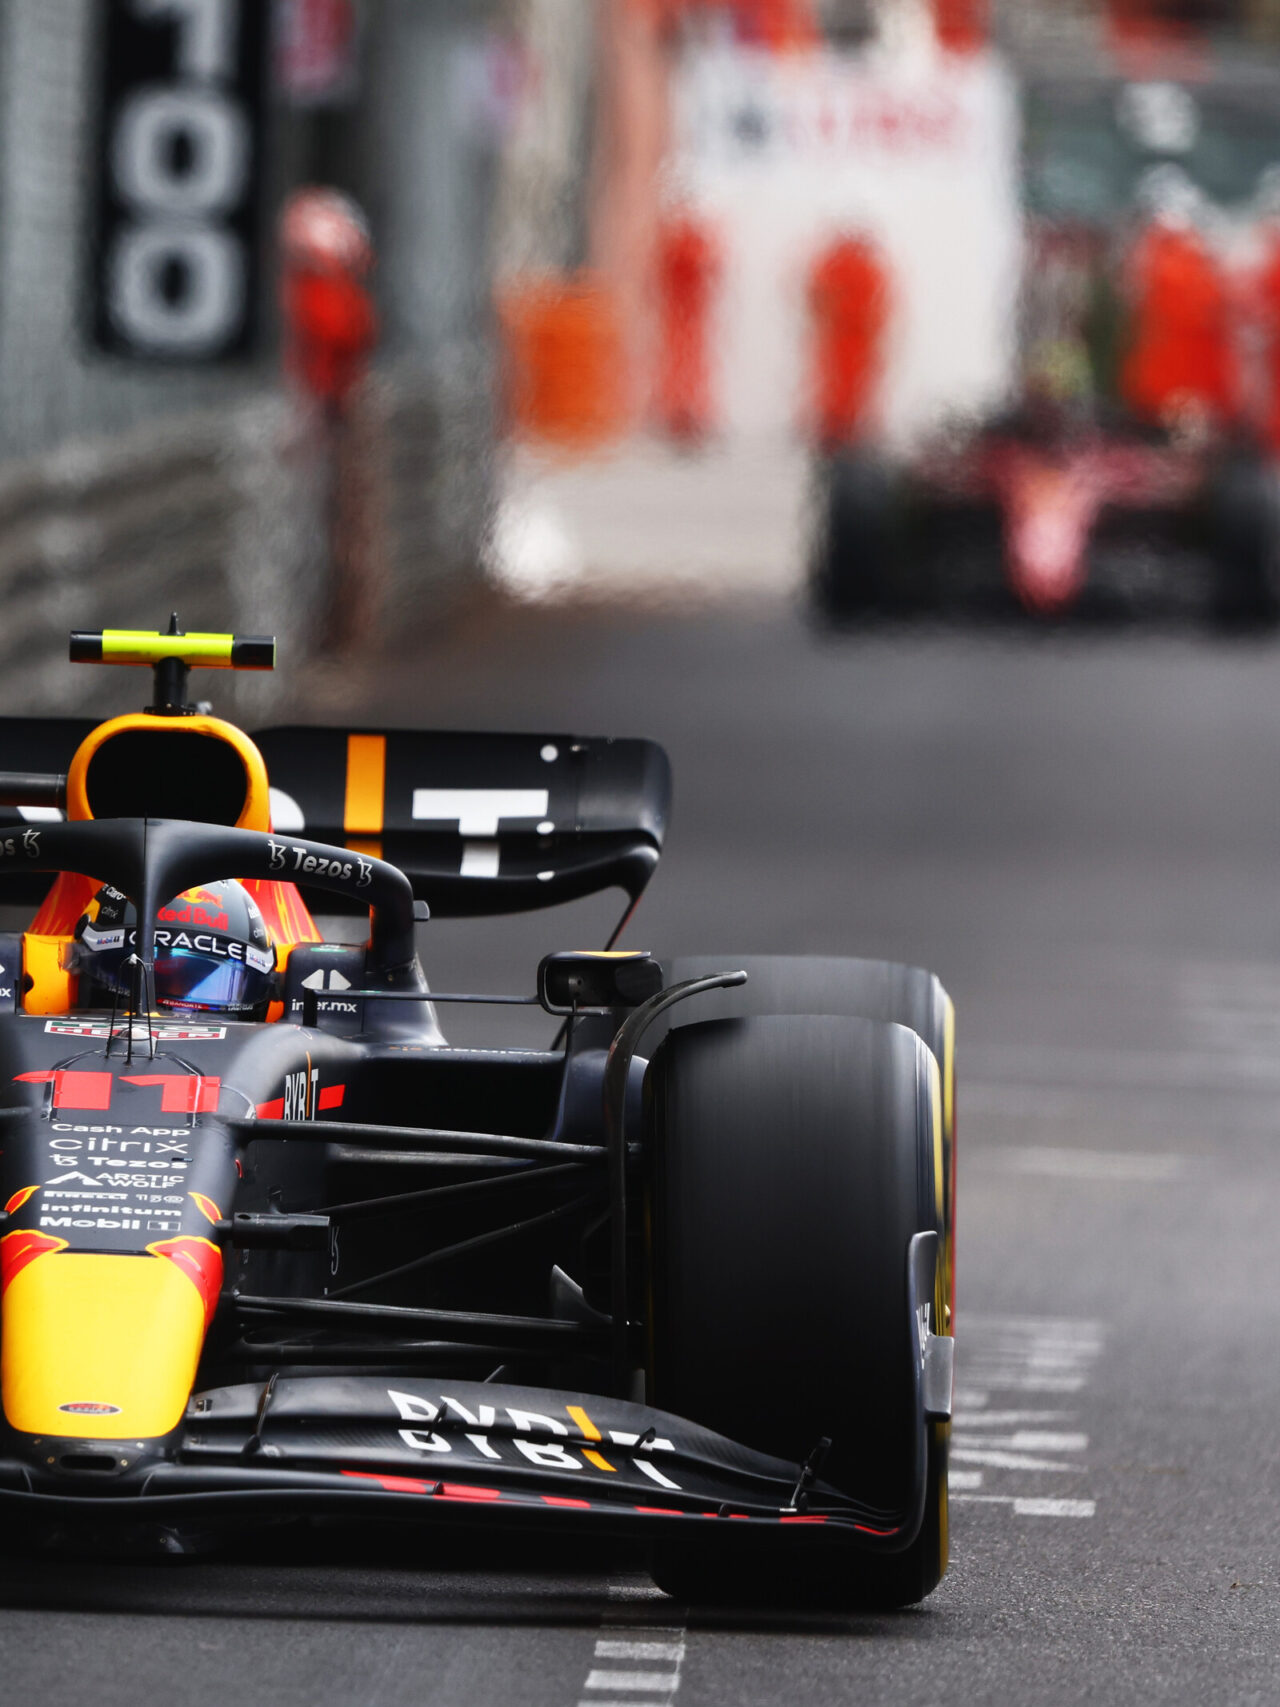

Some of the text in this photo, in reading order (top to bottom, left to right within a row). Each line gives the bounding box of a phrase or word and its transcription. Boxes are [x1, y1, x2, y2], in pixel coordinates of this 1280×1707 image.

[292, 846, 353, 880] Tezos
[193, 907, 229, 931] Bull
[129, 930, 242, 960] RACLE
[292, 998, 357, 1013] inr.mx
[54, 1026, 217, 1038] HEER
[13, 1070, 221, 1113] 11
[51, 1123, 191, 1137] Cash App
[87, 1156, 188, 1169] Tezos
[95, 1172, 185, 1183] ARCTIC
[107, 1179, 177, 1188] WOLF
[39, 1216, 141, 1230] Mobil
[387, 1389, 683, 1490] BYBIT
